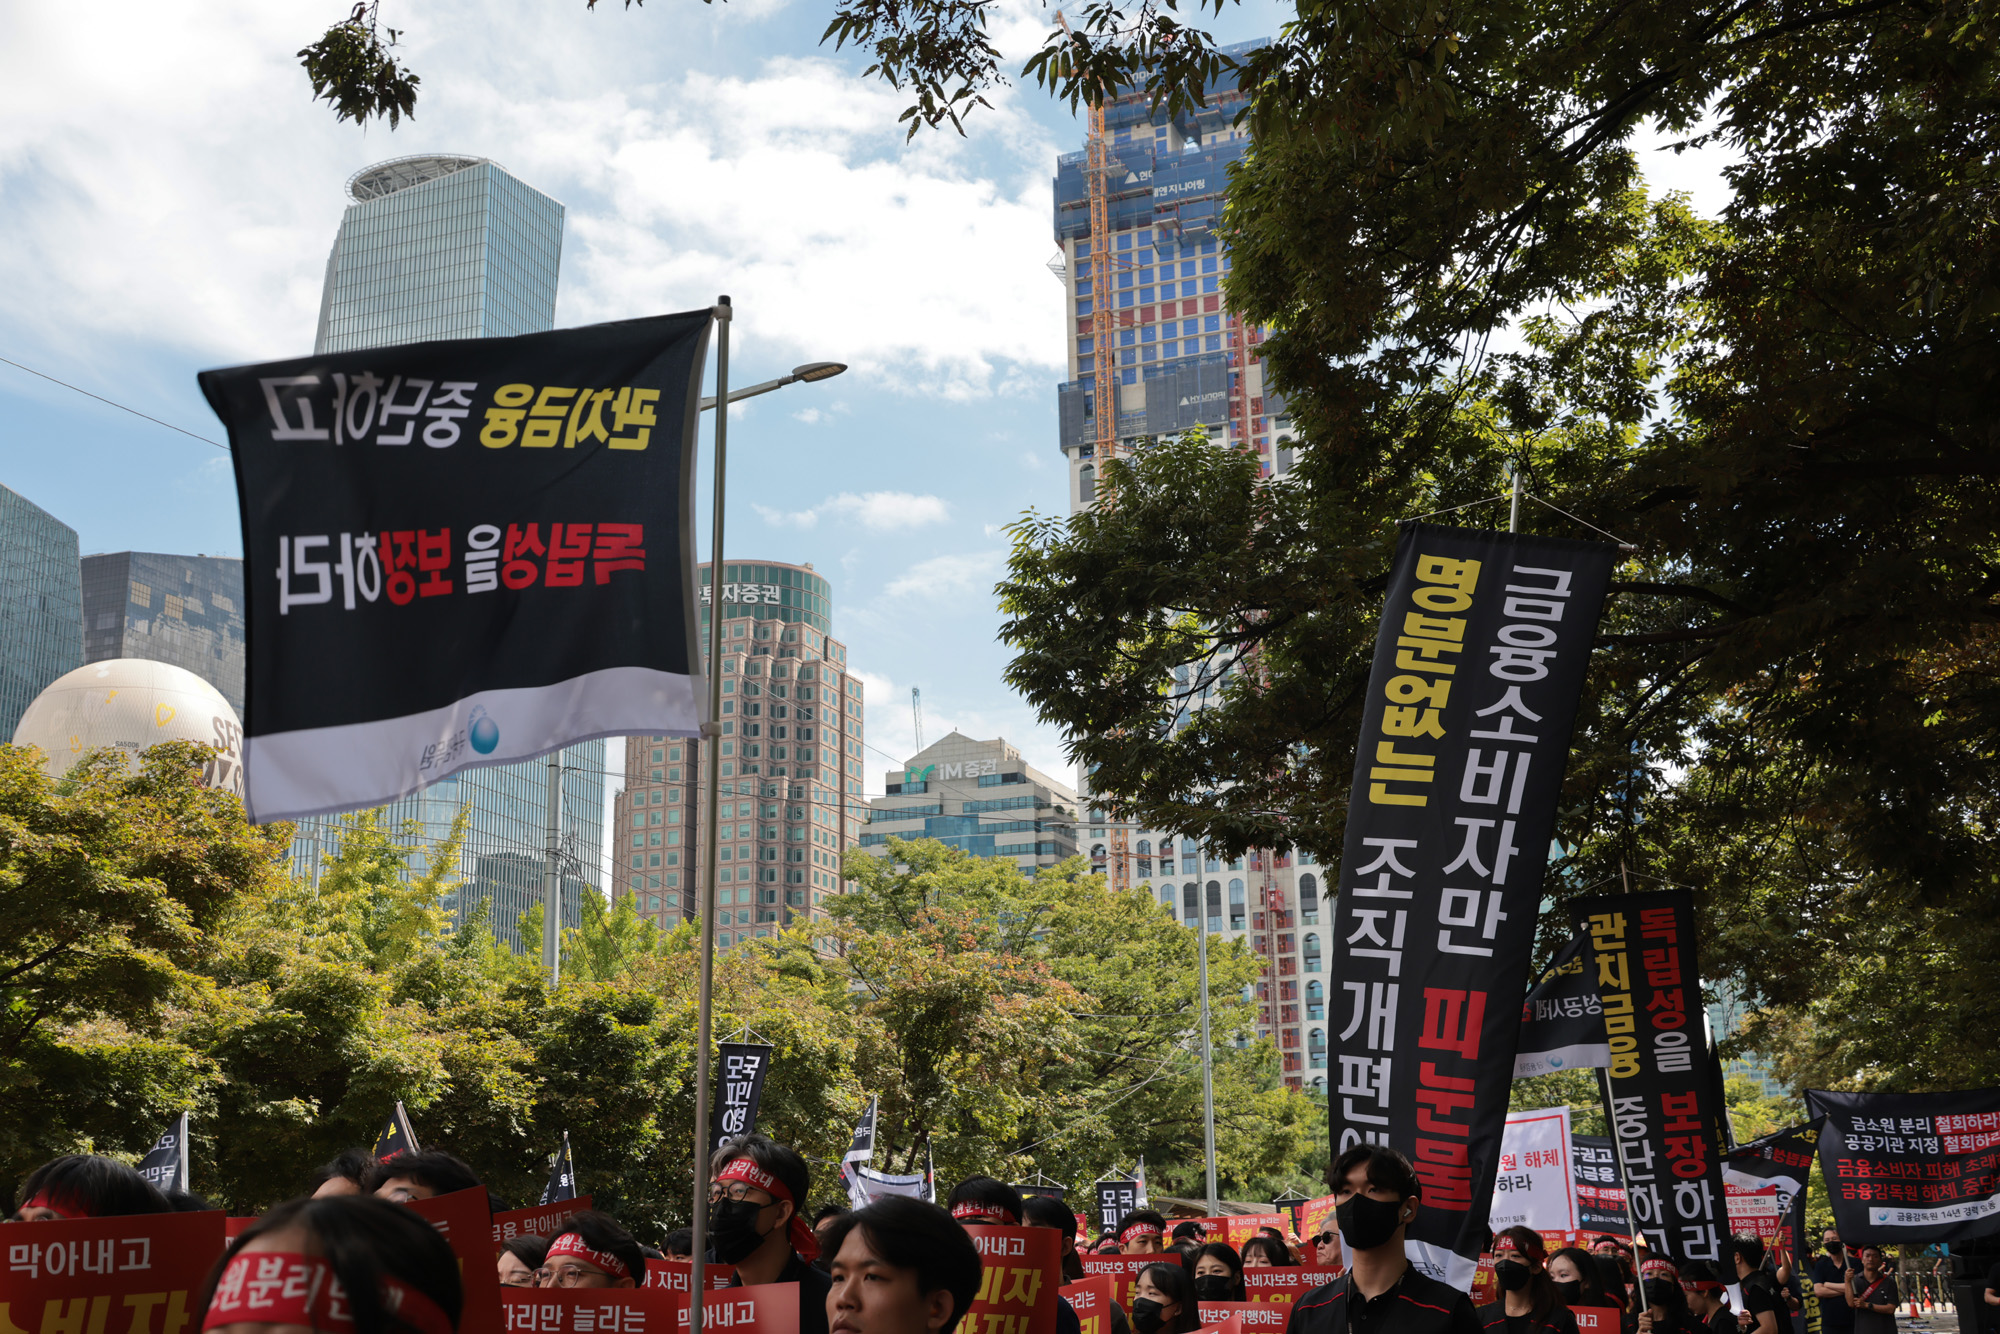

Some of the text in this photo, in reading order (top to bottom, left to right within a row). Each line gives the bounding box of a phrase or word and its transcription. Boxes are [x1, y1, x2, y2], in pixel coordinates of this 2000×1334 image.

[1368, 552, 1481, 808] 명분없는
[115, 740, 140, 749] SA5006
[1437, 563, 1573, 958] 금융소비자만
[1589, 912, 1641, 1079] 관치금융
[1413, 986, 1488, 1211] 피눈물
[1640, 907, 1721, 1262] 독립성을 보장하라
[1851, 1116, 1896, 1133] 금소원
[1899, 1117, 1931, 1134] 분리
[1844, 1134, 1905, 1153] 공공기관
[1909, 1137, 1939, 1154] 지정
[1524, 1148, 1559, 1169] 해체
[1836, 1159, 1922, 1178] 금융소비자
[1926, 1161, 1962, 1179] 피해
[1841, 1174, 2000, 1202] 금융감독원 해체 중단
[1897, 1211, 1938, 1222] 금융감독원
[1941, 1209, 1962, 1219] 14년
[9, 1237, 152, 1279] 막아내고
[657, 1271, 703, 1292] 자리
[573, 1305, 646, 1333] 늘리는
